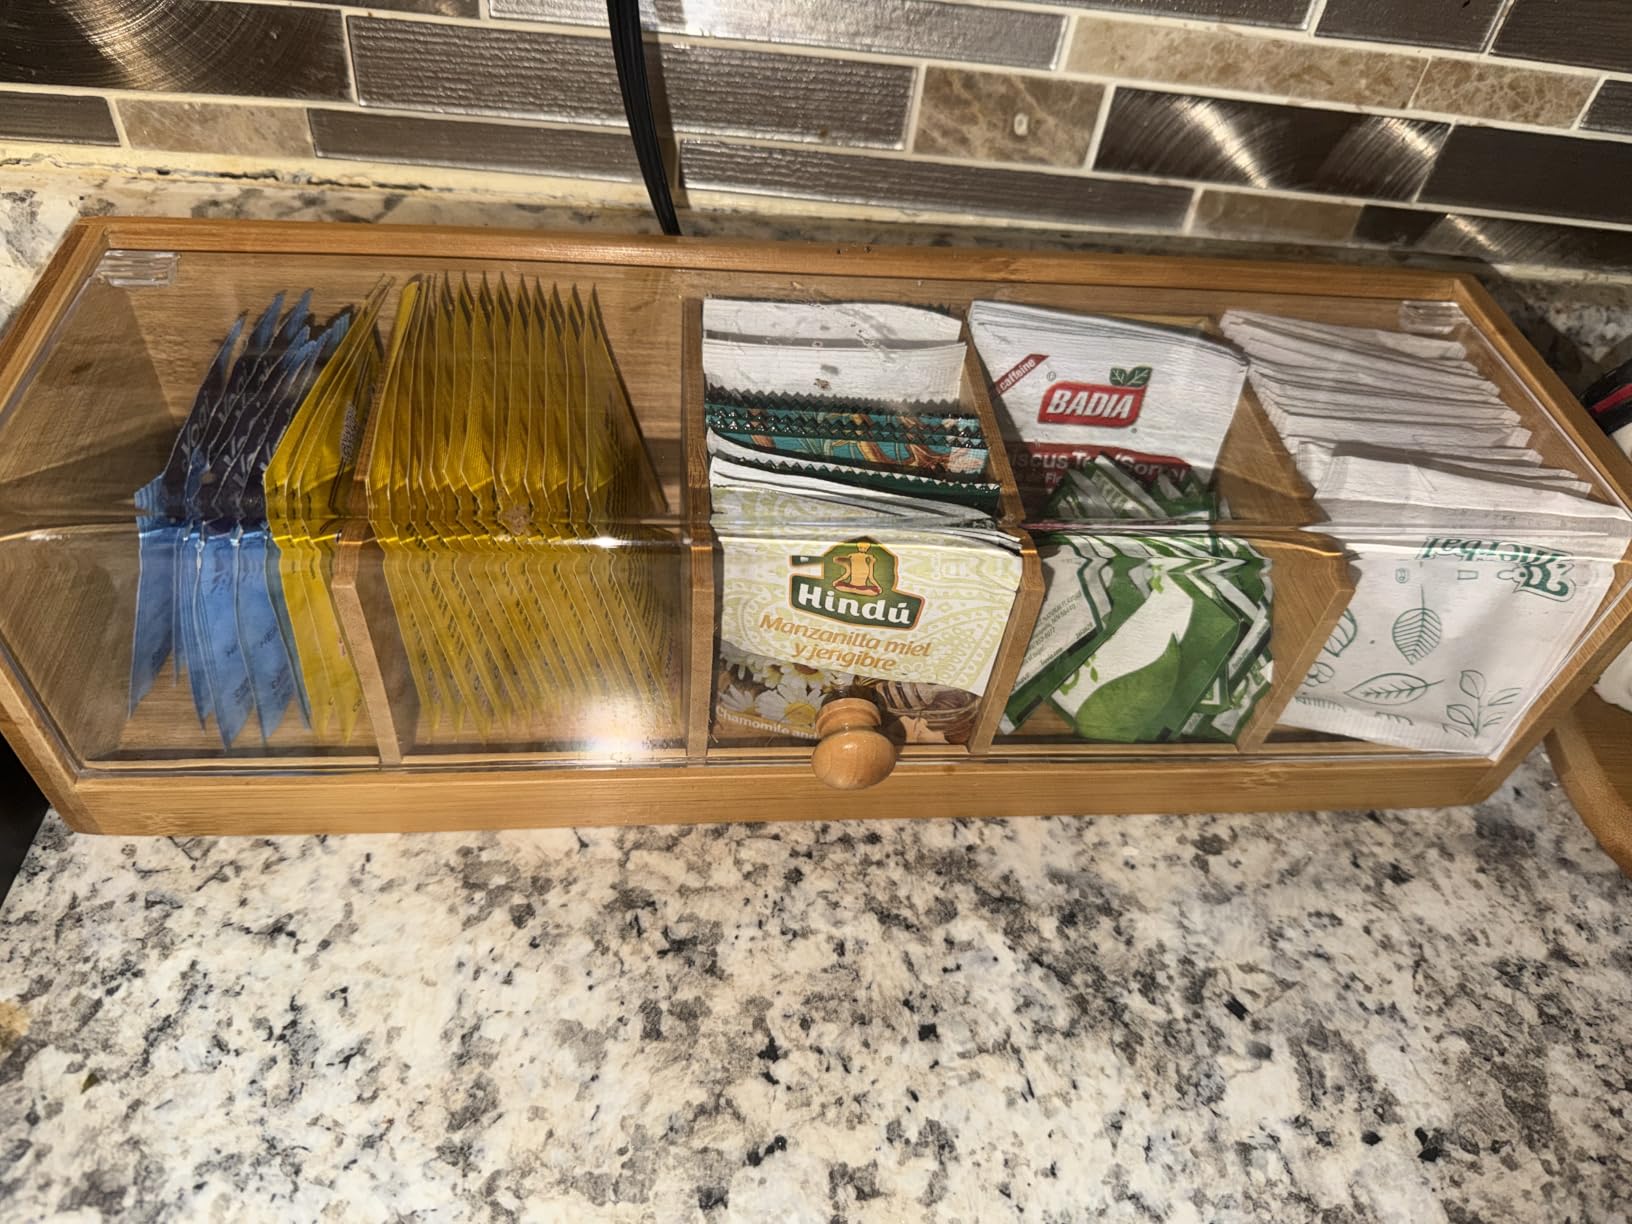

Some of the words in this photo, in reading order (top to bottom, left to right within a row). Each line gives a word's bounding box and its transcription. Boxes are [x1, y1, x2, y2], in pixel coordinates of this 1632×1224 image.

[1000, 360, 1035, 390] caffeine
[1046, 389, 1134, 420] BADIA
[798, 583, 911, 625] Hindú
[759, 614, 881, 650] Manzanilla
[881, 638, 932, 657] miel
[792, 643, 806, 658] y
[806, 646, 897, 671] jengibre
[715, 704, 790, 735] Chamomile
[792, 729, 819, 740] and
